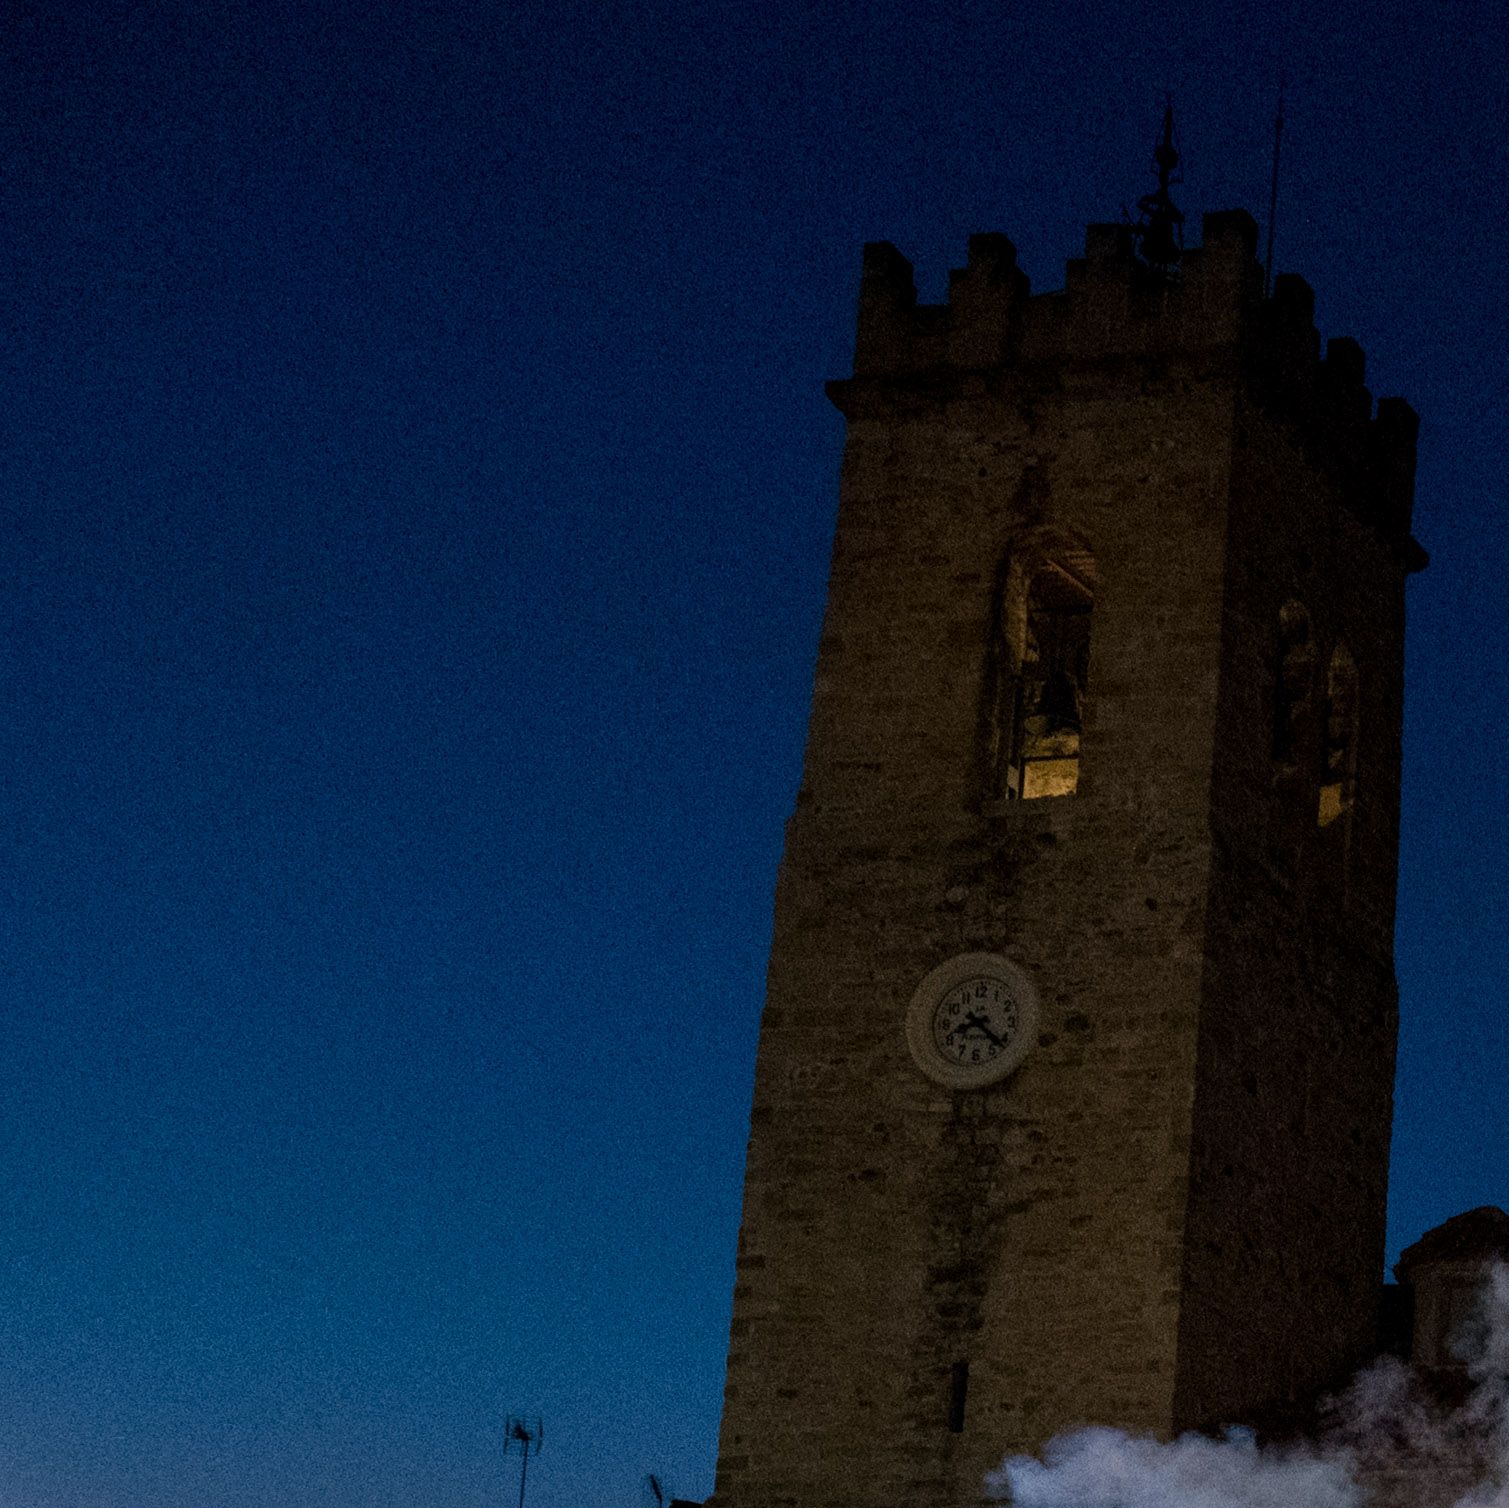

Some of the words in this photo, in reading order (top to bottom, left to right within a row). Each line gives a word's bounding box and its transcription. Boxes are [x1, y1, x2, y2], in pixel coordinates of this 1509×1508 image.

[976, 986, 988, 998] 12
[962, 992, 970, 1005] 11
[948, 1003, 960, 1015] 10
[1004, 1000, 1012, 1012] 2
[946, 1034, 954, 1046] 8
[959, 1044, 966, 1057] 7
[972, 1050, 980, 1061] 6
